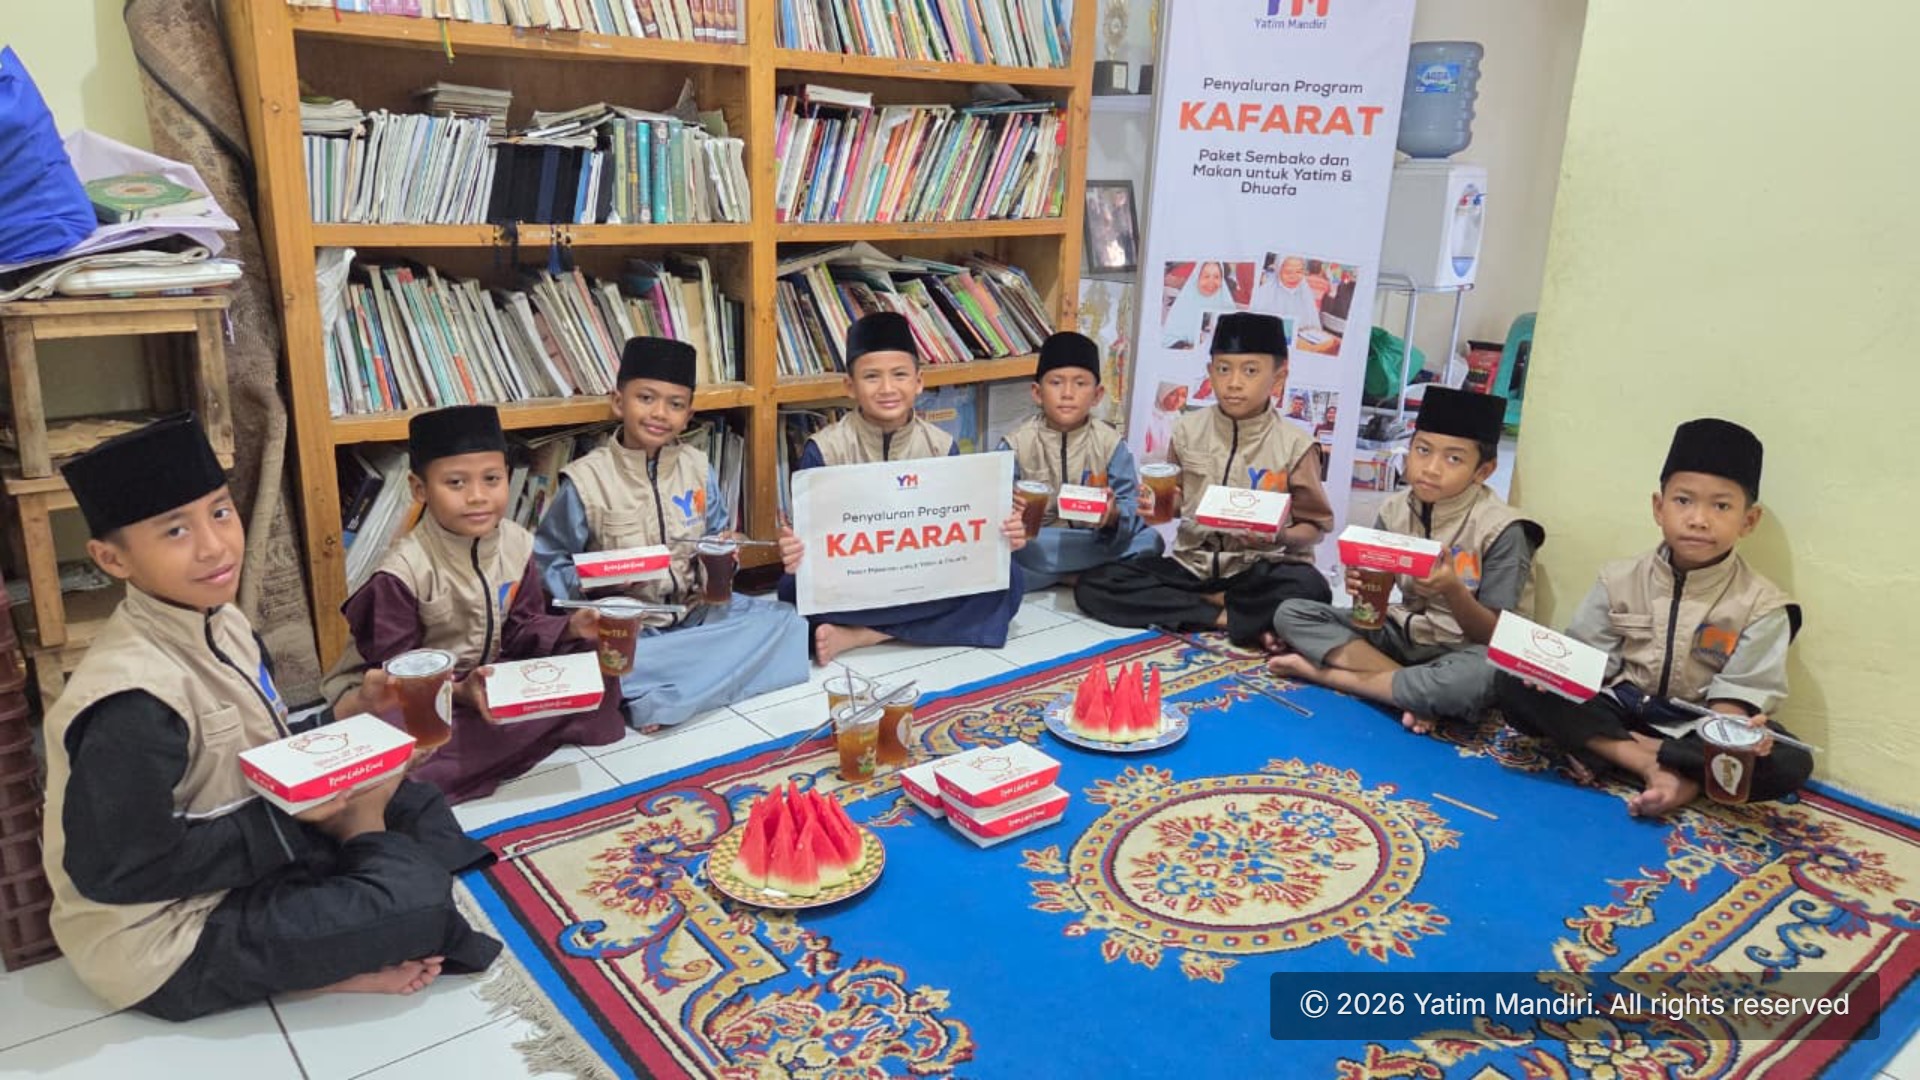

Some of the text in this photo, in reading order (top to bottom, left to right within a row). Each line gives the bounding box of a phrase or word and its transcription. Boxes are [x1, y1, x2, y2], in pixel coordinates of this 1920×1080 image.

[1255, 18, 1327, 29] Yatim Mandiri
[1203, 77, 1363, 97] Penyaluran Program
[1179, 101, 1383, 136] KAFARAT
[1199, 149, 1350, 166] Paket Sembako dan
[1193, 164, 1352, 182] Makan untuk Yatim &
[1241, 180, 1297, 196] Dhuafa
[896, 474, 919, 487] YM
[842, 502, 972, 524] Penyaluran Program
[825, 518, 987, 559] KAFARAT
